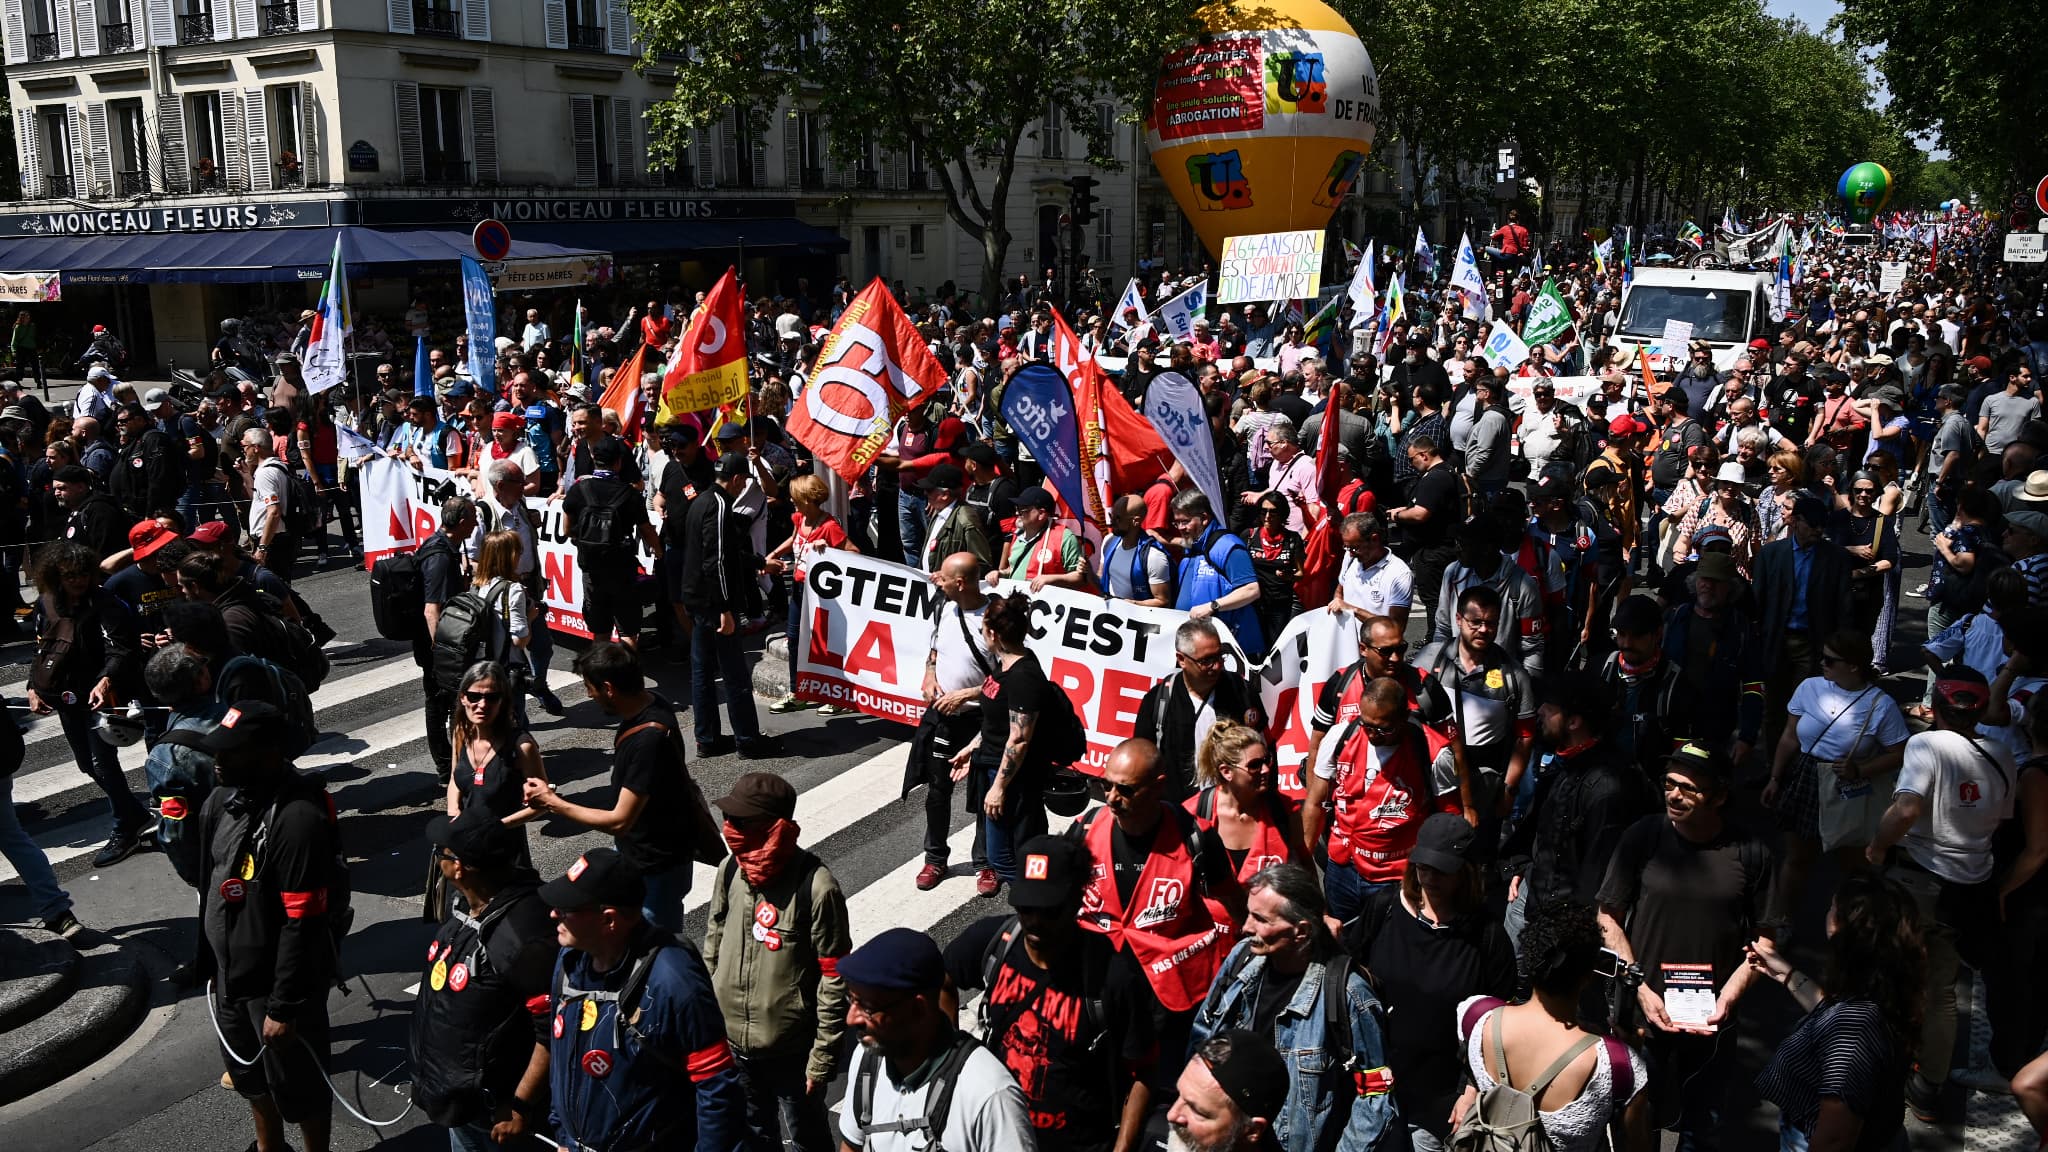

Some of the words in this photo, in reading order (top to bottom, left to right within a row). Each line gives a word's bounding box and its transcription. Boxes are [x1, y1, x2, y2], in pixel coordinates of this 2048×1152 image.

[1215, 67, 1243, 79] NON
[1334, 98, 1353, 121] DE
[49, 210, 151, 233] MONCEAU
[163, 205, 258, 230] FLEURS
[493, 201, 613, 221] MONCEAU
[625, 200, 714, 219] FLEURS
[2007, 247, 2043, 255] BABYLONE
[507, 269, 528, 283] FÊTE
[529, 271, 546, 282] DES
[1026, 599, 1161, 663] C'EST
[807, 607, 898, 686] LA
[1354, 846, 1371, 858] PAS
[1027, 857, 1047, 877] FO
[1148, 877, 1184, 909] FO
[756, 905, 774, 923] FO
[1151, 957, 1173, 975] PAS
[1172, 948, 1190, 965] QUE
[1189, 938, 1205, 956] DES
[450, 966, 465, 982] FO
